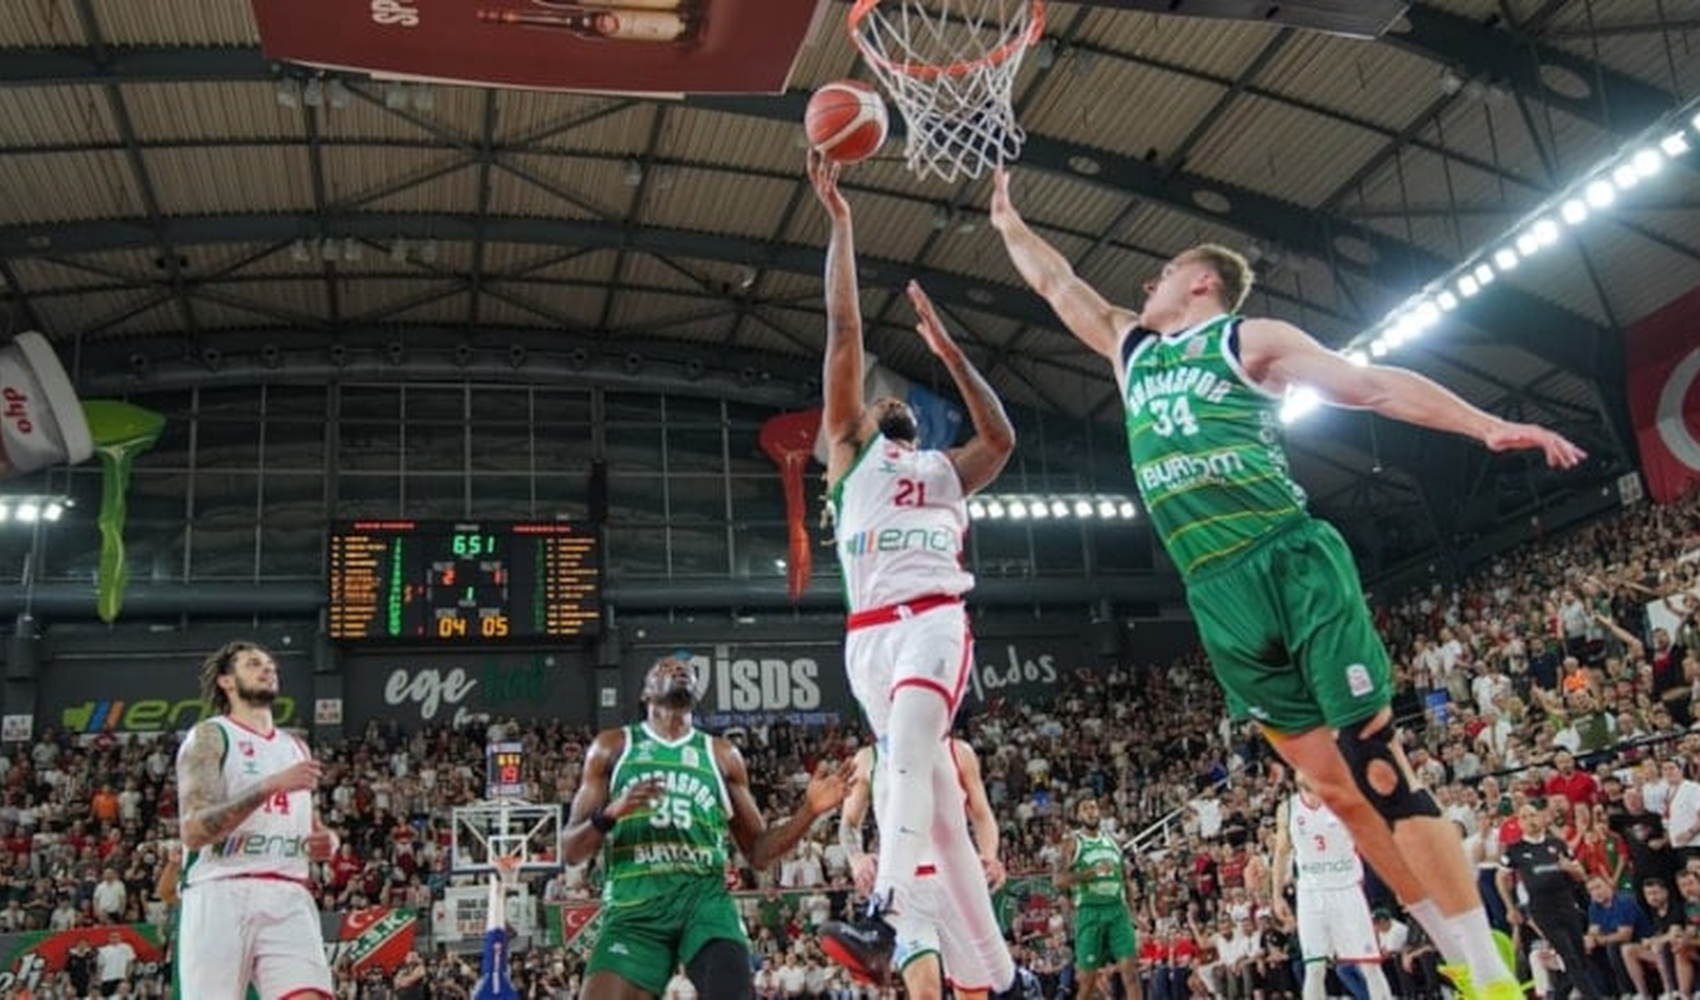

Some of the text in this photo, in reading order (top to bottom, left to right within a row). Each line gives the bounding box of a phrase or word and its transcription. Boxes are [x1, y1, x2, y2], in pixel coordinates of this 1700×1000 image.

[371, 0, 420, 26] SP
[1149, 396, 1199, 437] 34
[894, 478, 925, 507] 21
[438, 616, 467, 638] 04
[482, 616, 509, 637] 05
[262, 788, 291, 815] 14
[648, 795, 692, 830] 35
[1314, 834, 1326, 852] 3
